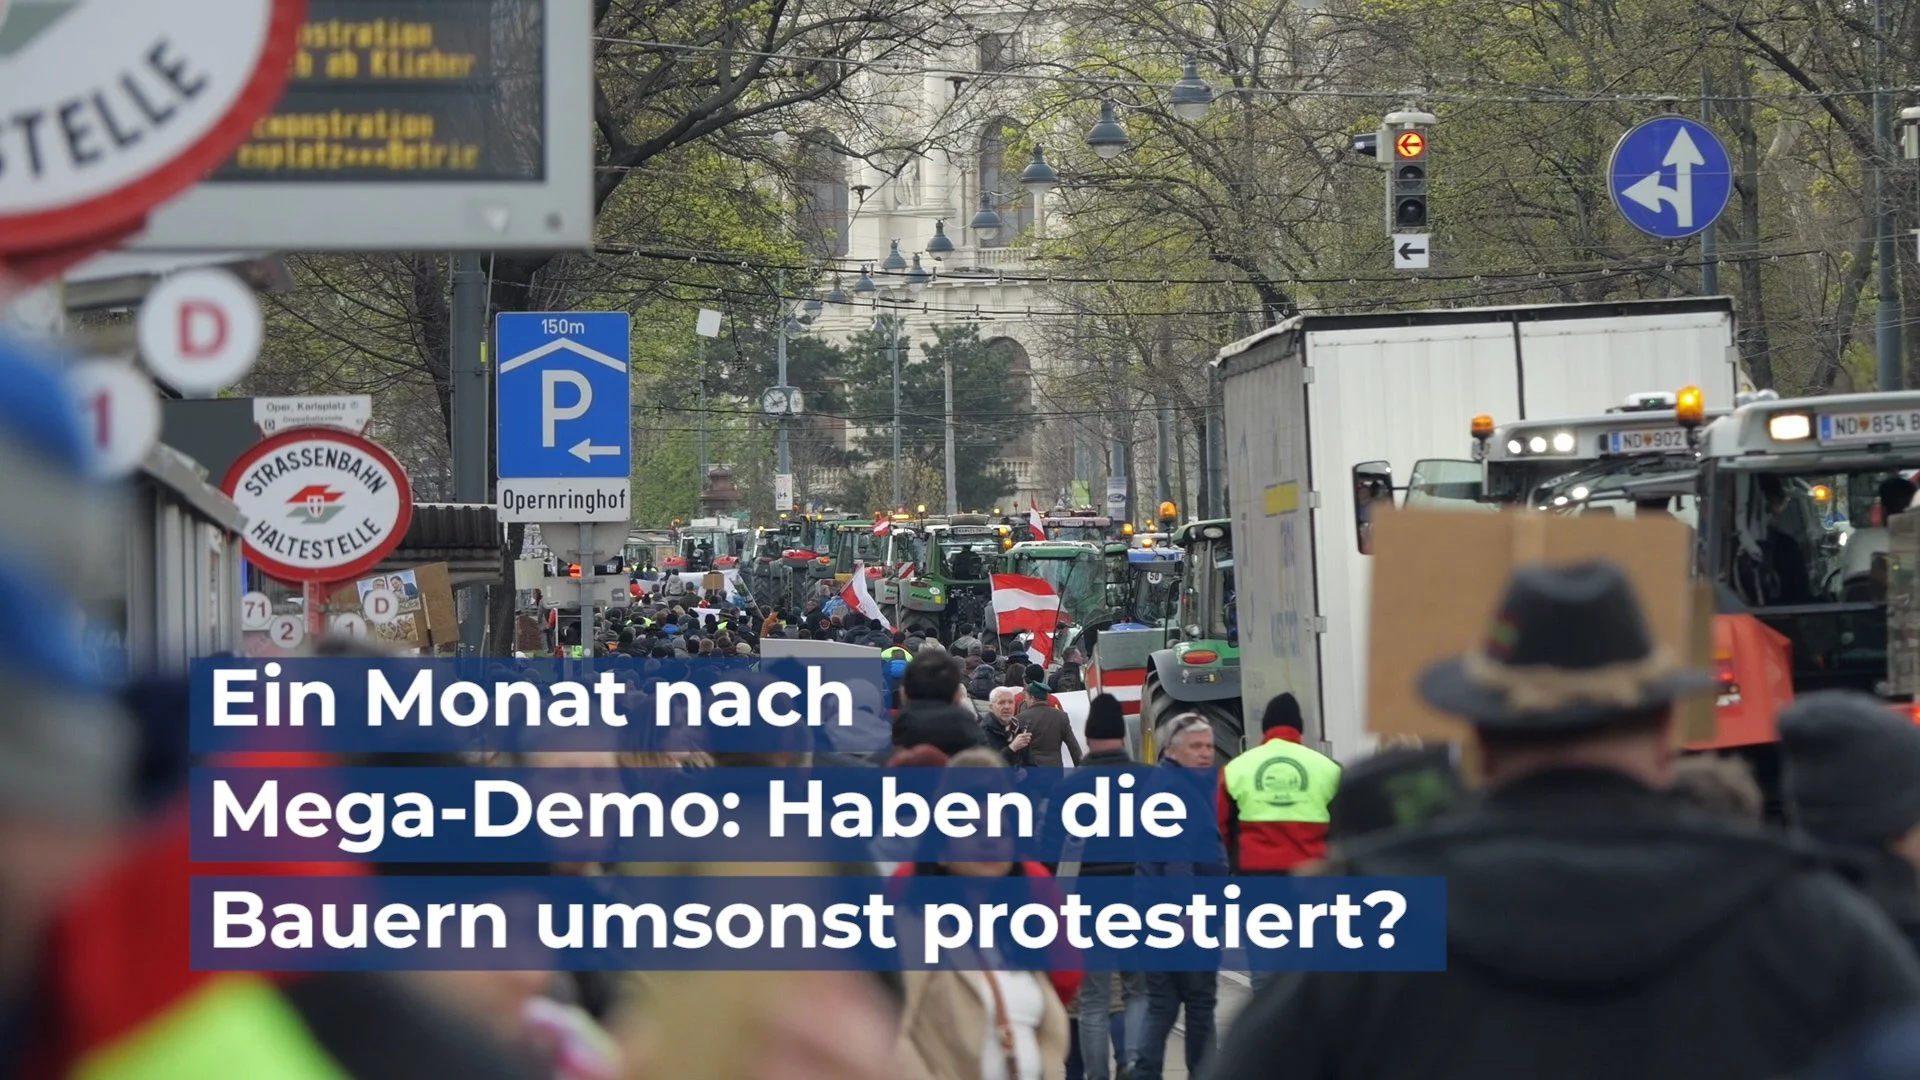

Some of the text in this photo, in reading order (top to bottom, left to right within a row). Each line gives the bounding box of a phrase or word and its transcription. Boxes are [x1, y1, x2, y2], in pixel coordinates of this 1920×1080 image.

[0, 36, 209, 178] TELLE
[178, 300, 230, 358] D
[541, 318, 585, 335] 150m
[266, 401, 347, 413] Oper, Karlsplatz
[541, 369, 593, 448] P
[1654, 430, 1682, 448] 902
[244, 447, 388, 497] STRASSENBAHN
[503, 488, 626, 515] Opernringhof
[251, 517, 382, 561] HALTESTELLE
[244, 601, 266, 618] 71
[374, 598, 389, 614] D
[280, 622, 294, 640] 2
